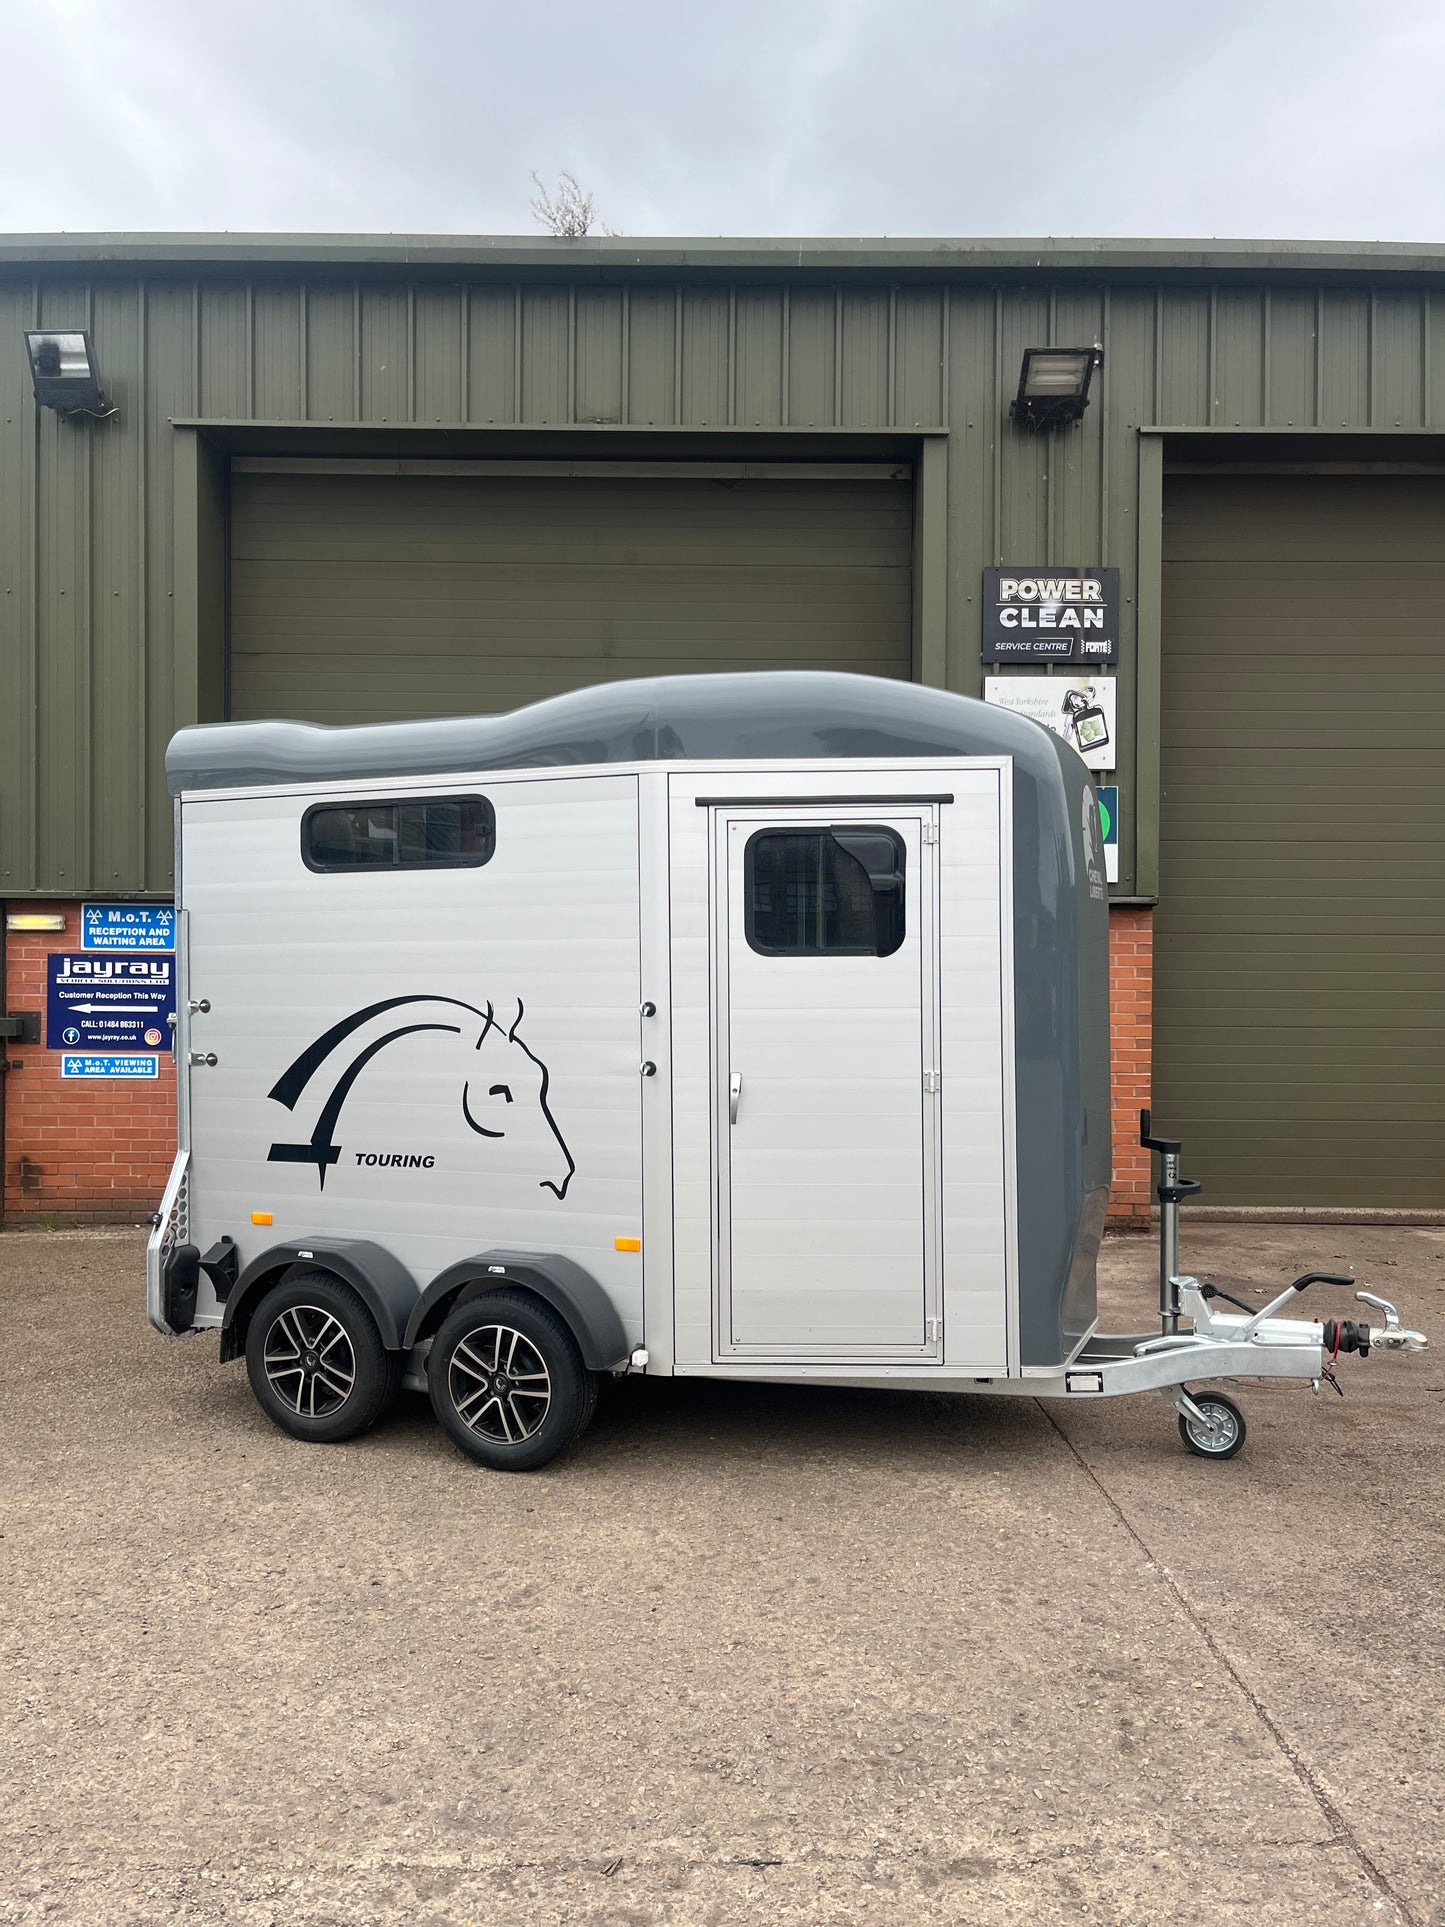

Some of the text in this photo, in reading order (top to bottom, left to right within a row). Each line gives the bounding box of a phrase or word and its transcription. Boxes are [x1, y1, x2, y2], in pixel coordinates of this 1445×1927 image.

[999, 578, 1103, 602] POWER
[999, 607, 1104, 628] CLEAN
[995, 642, 1068, 651] SERVICE CENTRE
[108, 911, 152, 923] M.o.T.
[89, 927, 170, 936] RECEPTION AND
[93, 937, 166, 946] WAITING AREA
[56, 957, 169, 979] jayray
[59, 991, 167, 1001] Customer Reception This Way
[81, 1020, 98, 1028] CALL:
[98, 1020, 119, 1028] 01484
[355, 1153, 435, 1168] TOURING
